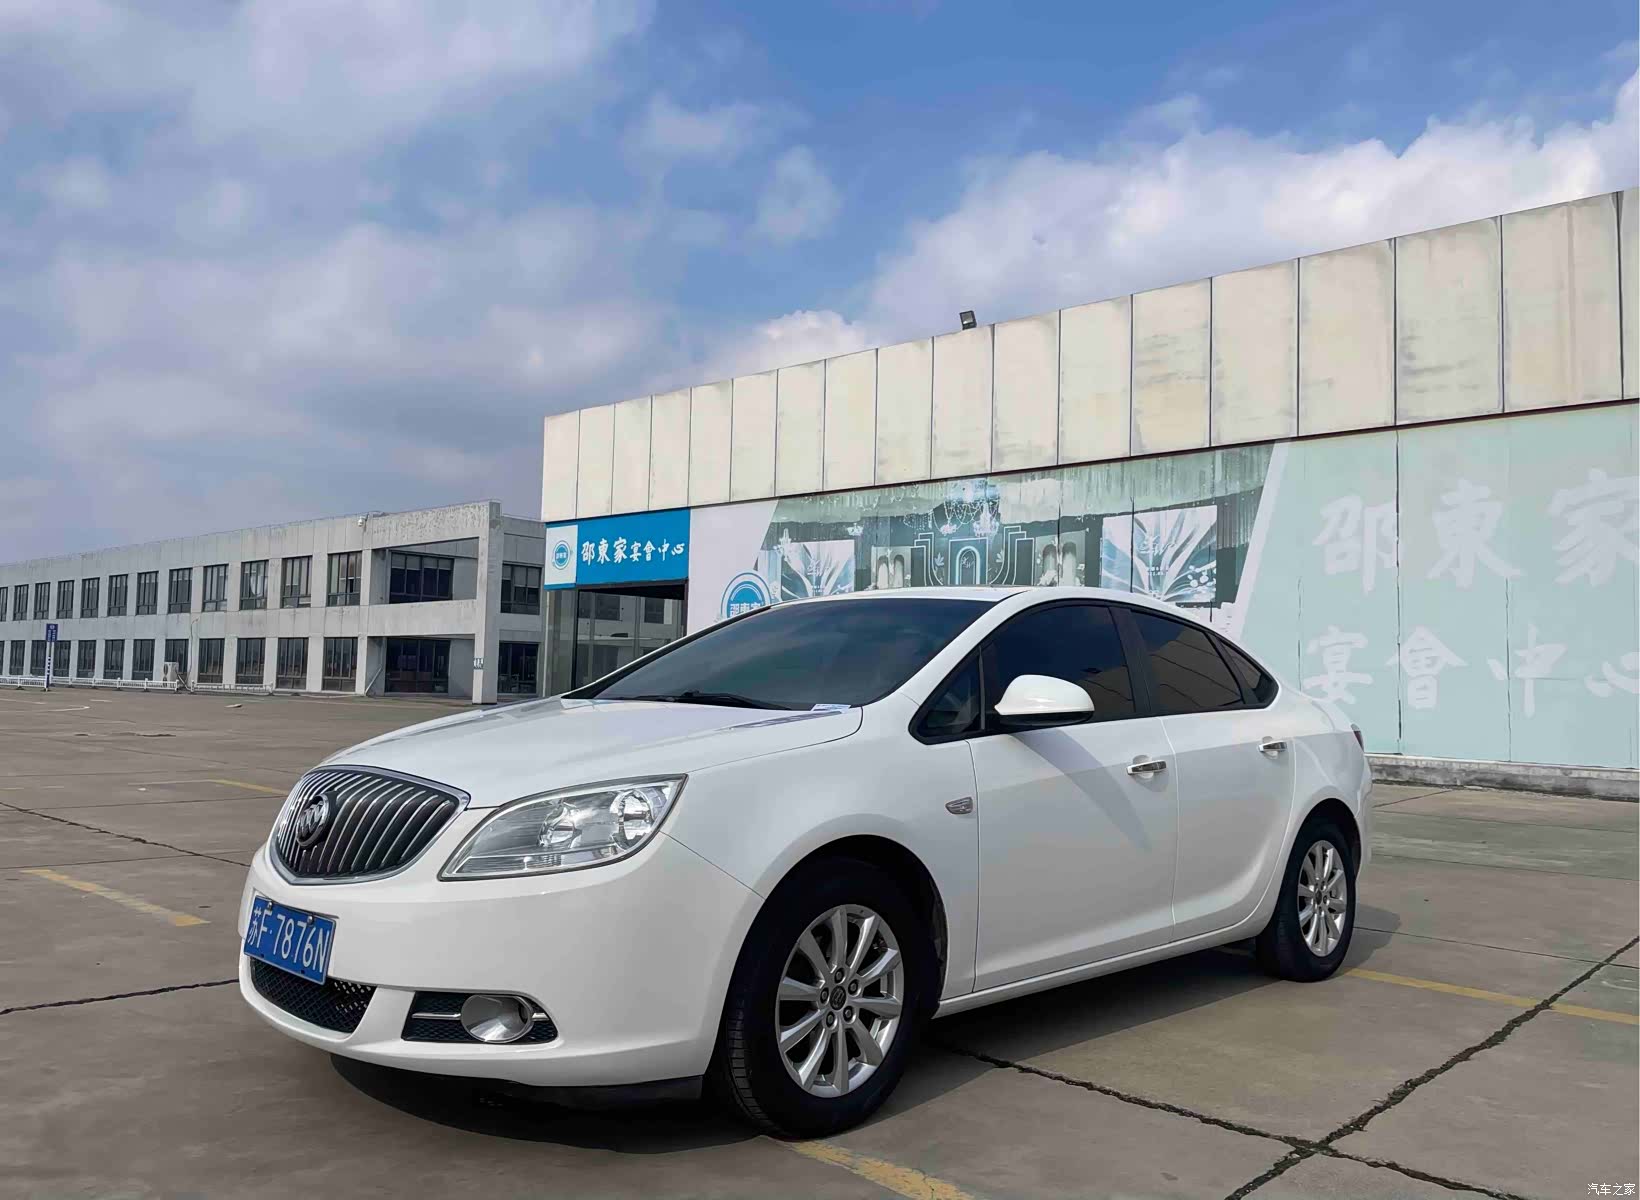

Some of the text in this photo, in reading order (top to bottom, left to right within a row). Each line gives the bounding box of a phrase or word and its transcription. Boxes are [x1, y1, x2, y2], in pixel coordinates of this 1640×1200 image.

[581, 537, 685, 565] 邵東家宴會中心
